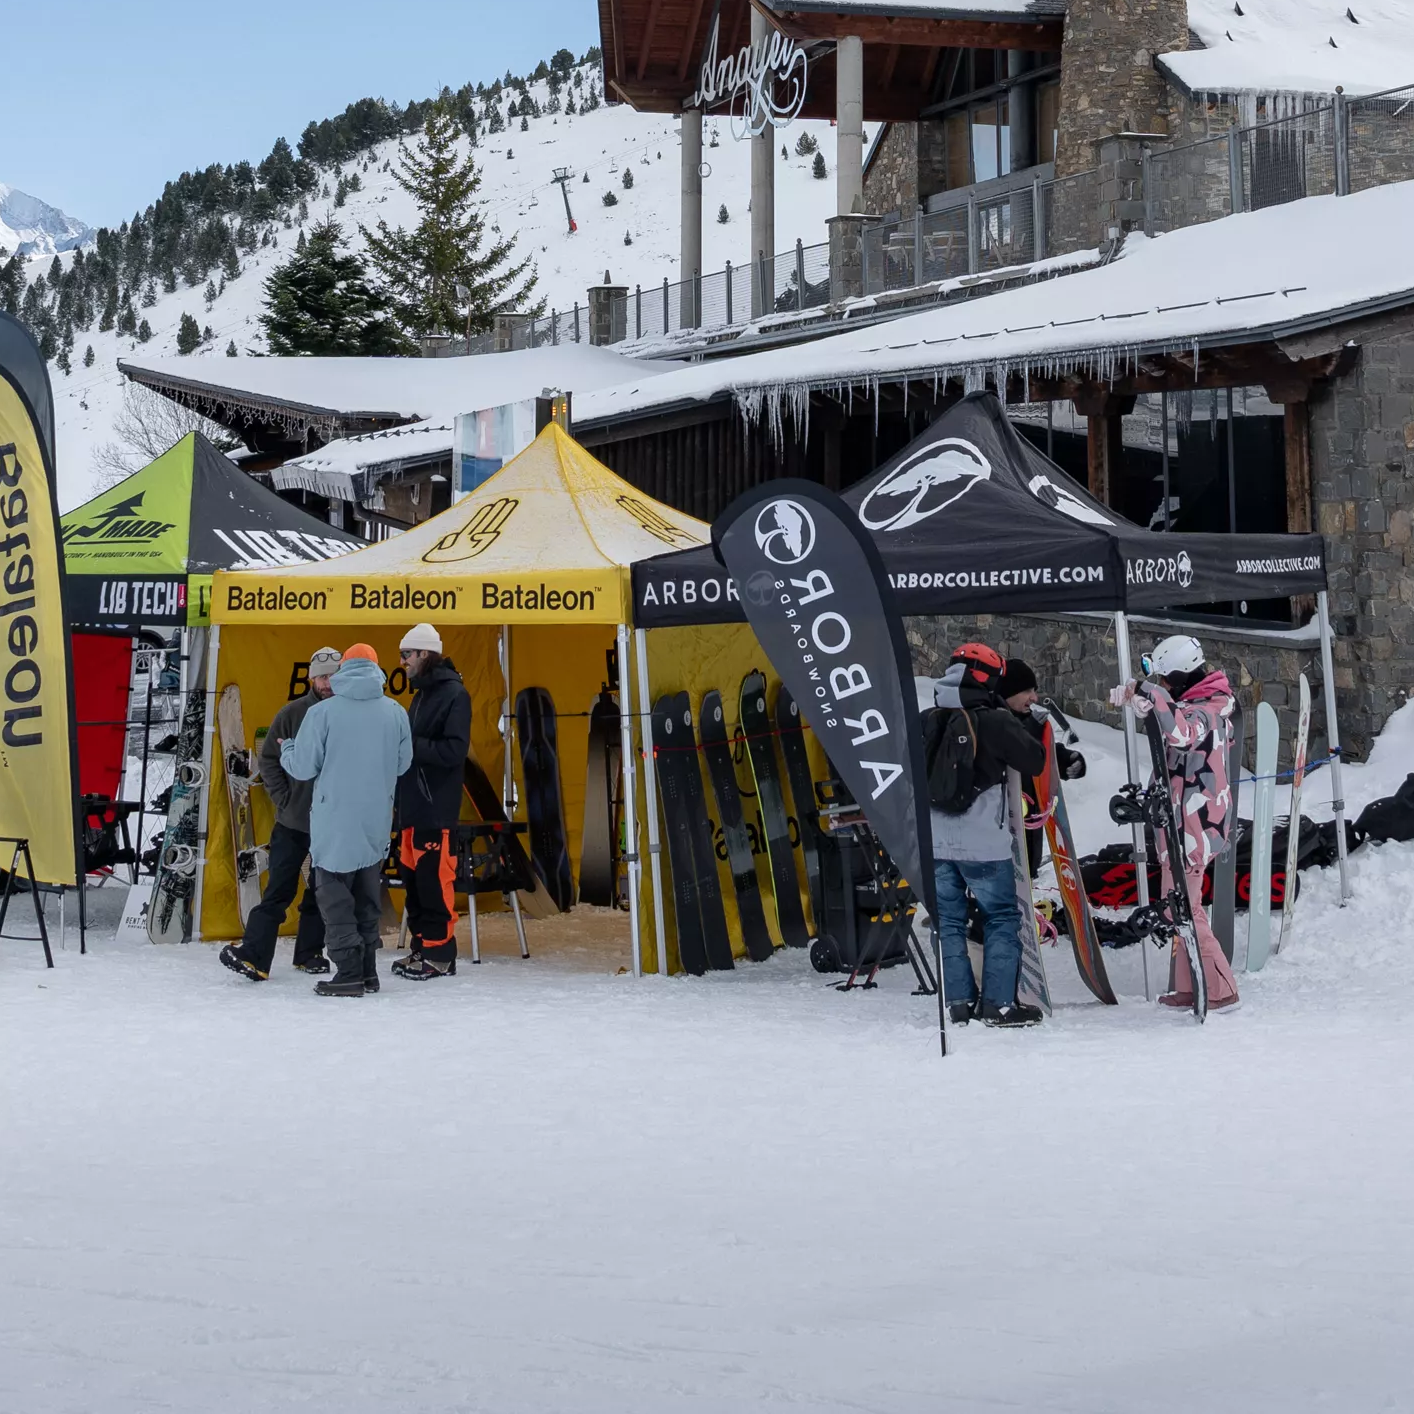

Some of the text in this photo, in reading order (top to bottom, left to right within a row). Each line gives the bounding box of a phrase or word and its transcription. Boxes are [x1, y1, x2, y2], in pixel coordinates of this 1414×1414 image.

[98, 520, 177, 539] MADE
[1126, 556, 1175, 585] ARBOR
[1236, 556, 1321, 574] ARBORCOLLECTIVE.COM
[99, 581, 129, 614] LIB
[132, 582, 178, 615] TECH
[643, 577, 740, 606] ARBOR
